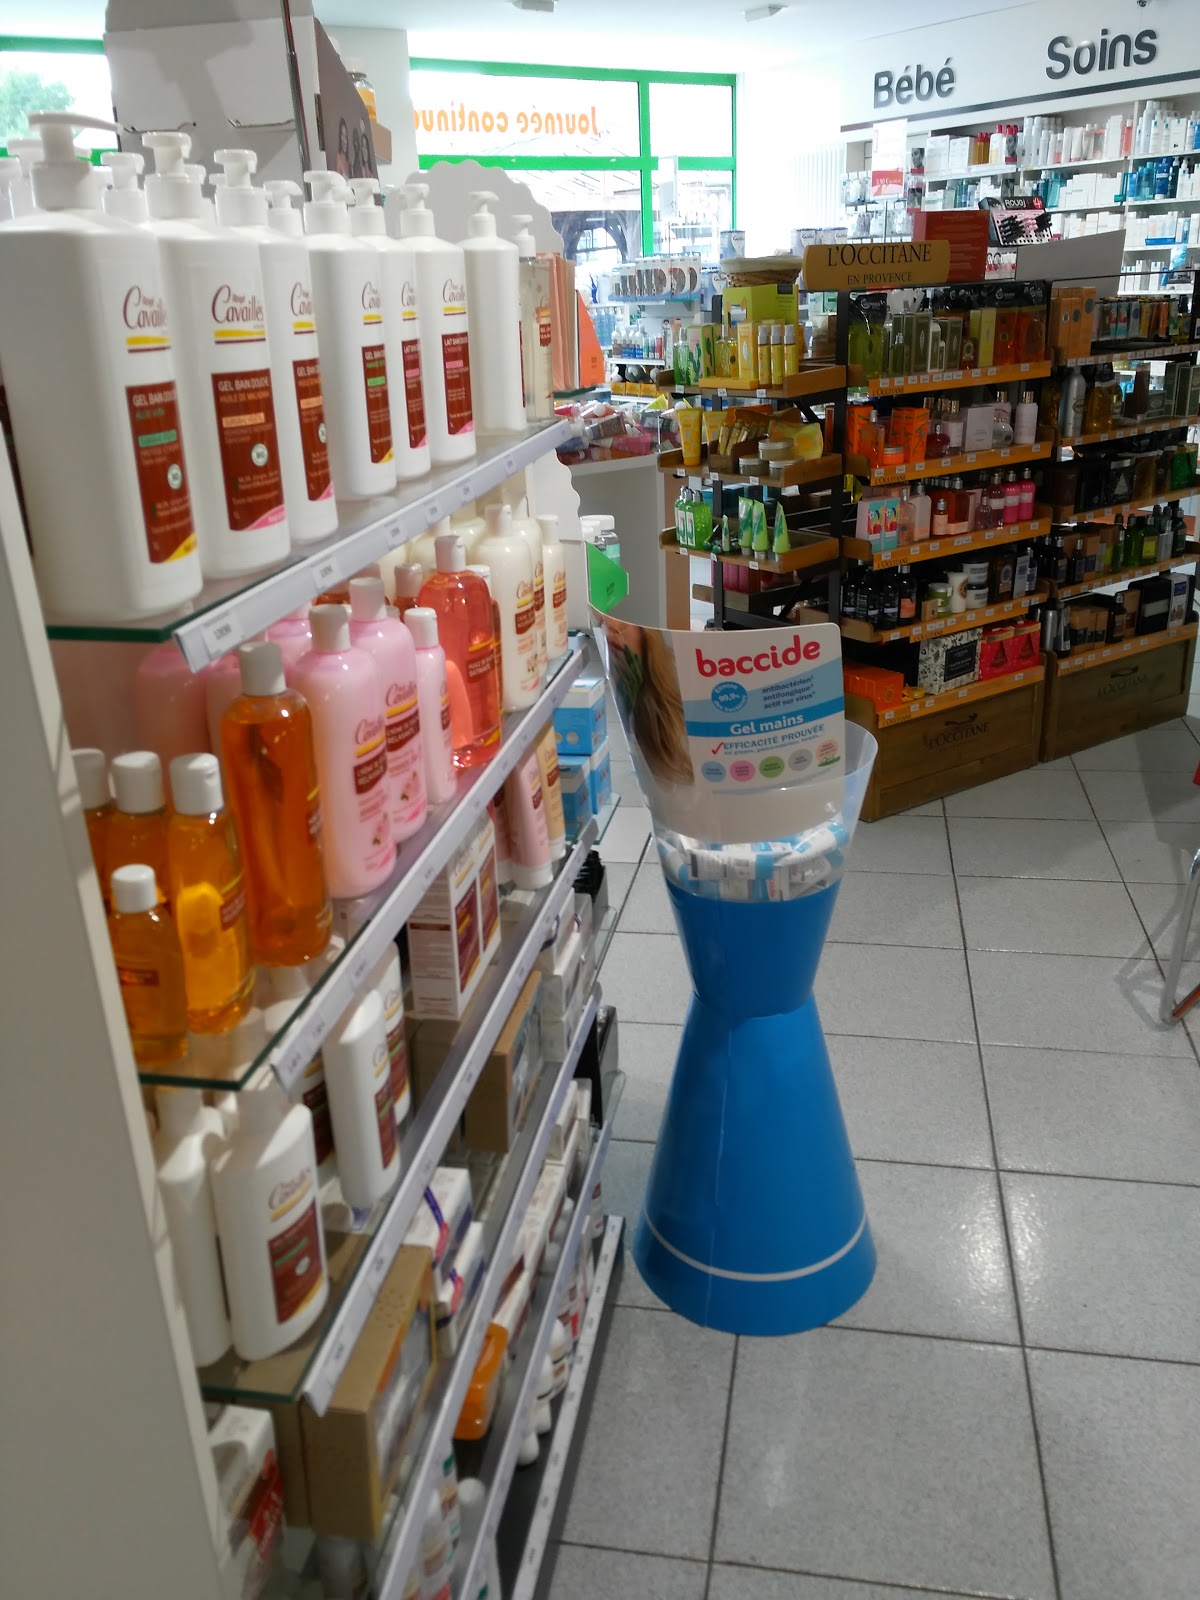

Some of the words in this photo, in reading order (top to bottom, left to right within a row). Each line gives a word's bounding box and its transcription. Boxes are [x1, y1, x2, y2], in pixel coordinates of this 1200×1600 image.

[1045, 28, 1158, 80] Soins
[873, 57, 956, 109] Bébé
[827, 243, 932, 267] L'OCCITANE
[847, 274, 860, 285] EN
[863, 271, 912, 284] PROVENCE
[218, 380, 234, 392] GEL
[234, 378, 250, 390] BAIN
[132, 394, 148, 407] GEL
[695, 634, 821, 678] baccide
[763, 701, 781, 710] actif
[782, 698, 794, 706] sur
[730, 721, 757, 735] Gel
[760, 714, 804, 732] mains
[928, 722, 990, 750] L'OCCITANE
